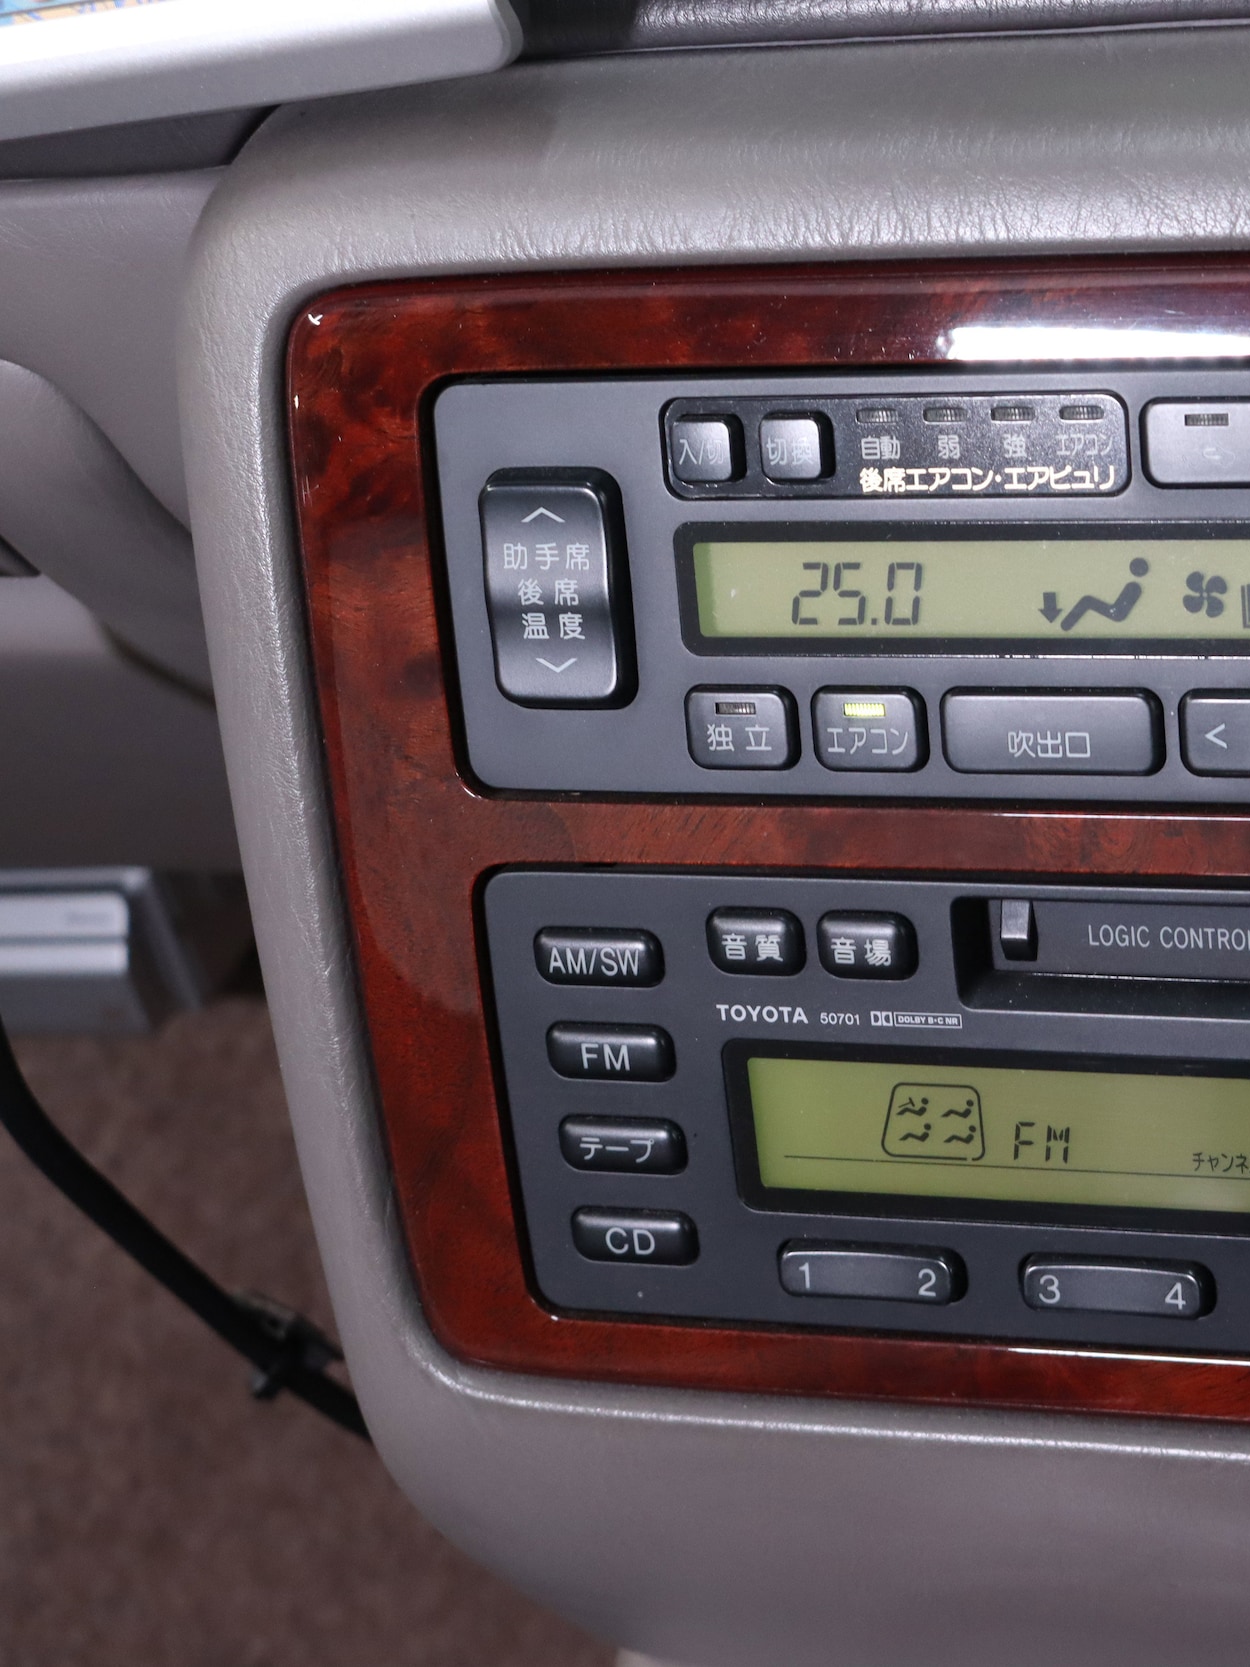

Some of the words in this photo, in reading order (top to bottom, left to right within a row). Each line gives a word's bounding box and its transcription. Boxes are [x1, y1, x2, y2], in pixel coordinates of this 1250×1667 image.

[766, 437, 814, 465] 切換
[861, 436, 900, 460] 自動
[938, 435, 960, 459] 弱
[1003, 434, 1027, 458] 強
[1056, 434, 1113, 457] エアコン
[503, 542, 590, 571] 助手席
[518, 578, 579, 606] 後席
[791, 562, 923, 627] 25.0
[522, 611, 586, 640] 温度
[706, 724, 773, 753] 独立
[826, 726, 908, 756] エアコン
[1007, 731, 1091, 759] 吹出口
[721, 933, 784, 962] 音質
[1088, 925, 1151, 948] LOGIC
[548, 947, 640, 977] AM/SW
[830, 936, 892, 967] 音場
[716, 1004, 809, 1024] TOYOTA
[820, 1013, 860, 1026] 50701
[897, 1015, 926, 1024] DOLBY
[945, 1017, 959, 1026] NR
[581, 1043, 631, 1071] FM
[579, 1137, 656, 1163] テープ
[1014, 1121, 1071, 1164] FM
[605, 1227, 656, 1255] CD
[798, 1262, 811, 1290] 1
[917, 1268, 937, 1297] 2
[1038, 1275, 1061, 1304] 3
[1165, 1282, 1187, 1311] 4
